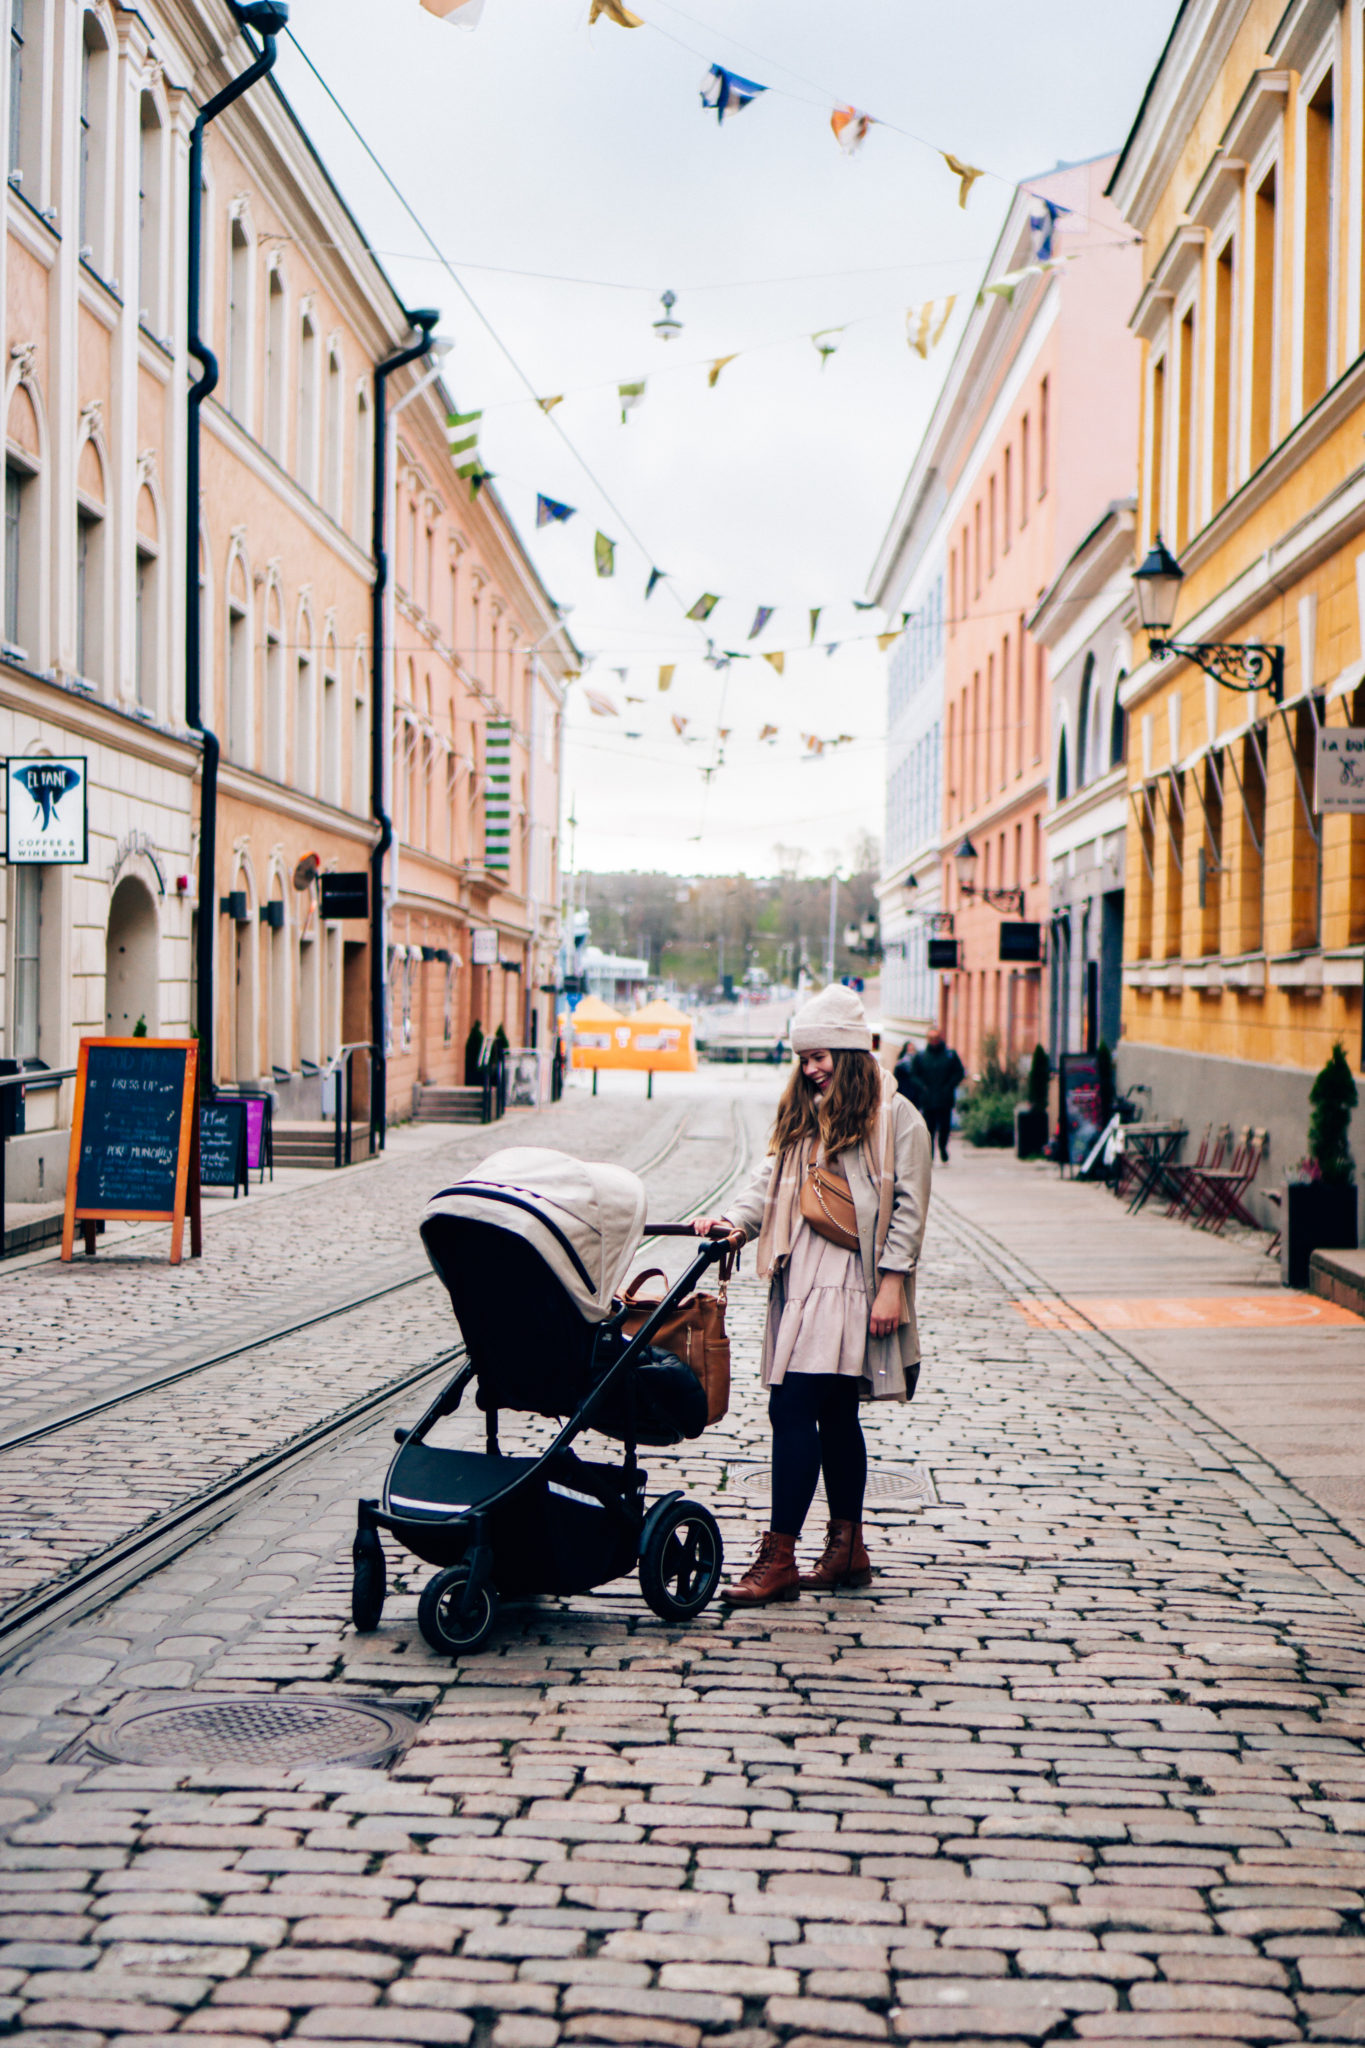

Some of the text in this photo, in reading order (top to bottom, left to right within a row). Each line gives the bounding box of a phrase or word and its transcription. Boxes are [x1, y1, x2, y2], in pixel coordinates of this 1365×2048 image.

[27, 771, 39, 788] EL
[18, 839, 75, 847] COFFEE &
